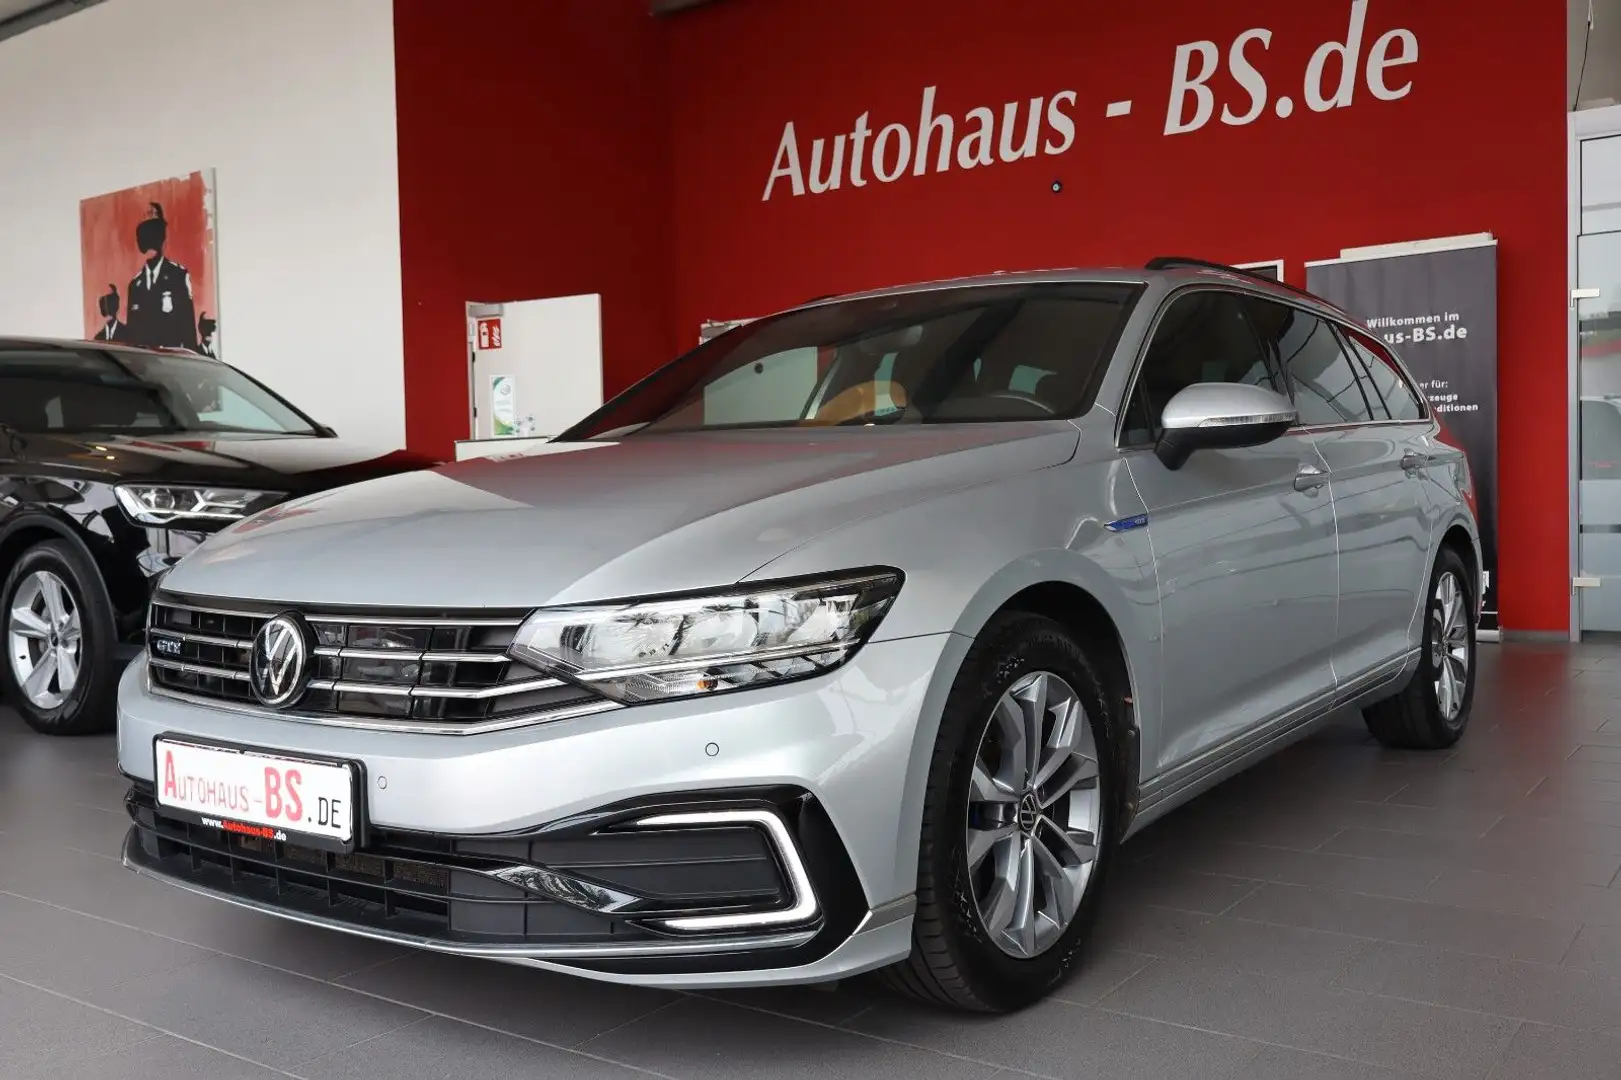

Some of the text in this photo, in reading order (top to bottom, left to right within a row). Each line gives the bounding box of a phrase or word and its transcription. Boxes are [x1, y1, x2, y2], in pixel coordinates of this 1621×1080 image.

[762, 85, 1077, 201] Autohaus
[1163, 0, 1419, 136] BS.de
[1366, 311, 1460, 329] Willkommen im
[1384, 324, 1468, 344] us-BS.de
[1431, 380, 1449, 389] für:
[1427, 393, 1458, 403] zeuge
[1434, 404, 1479, 413] ditionen
